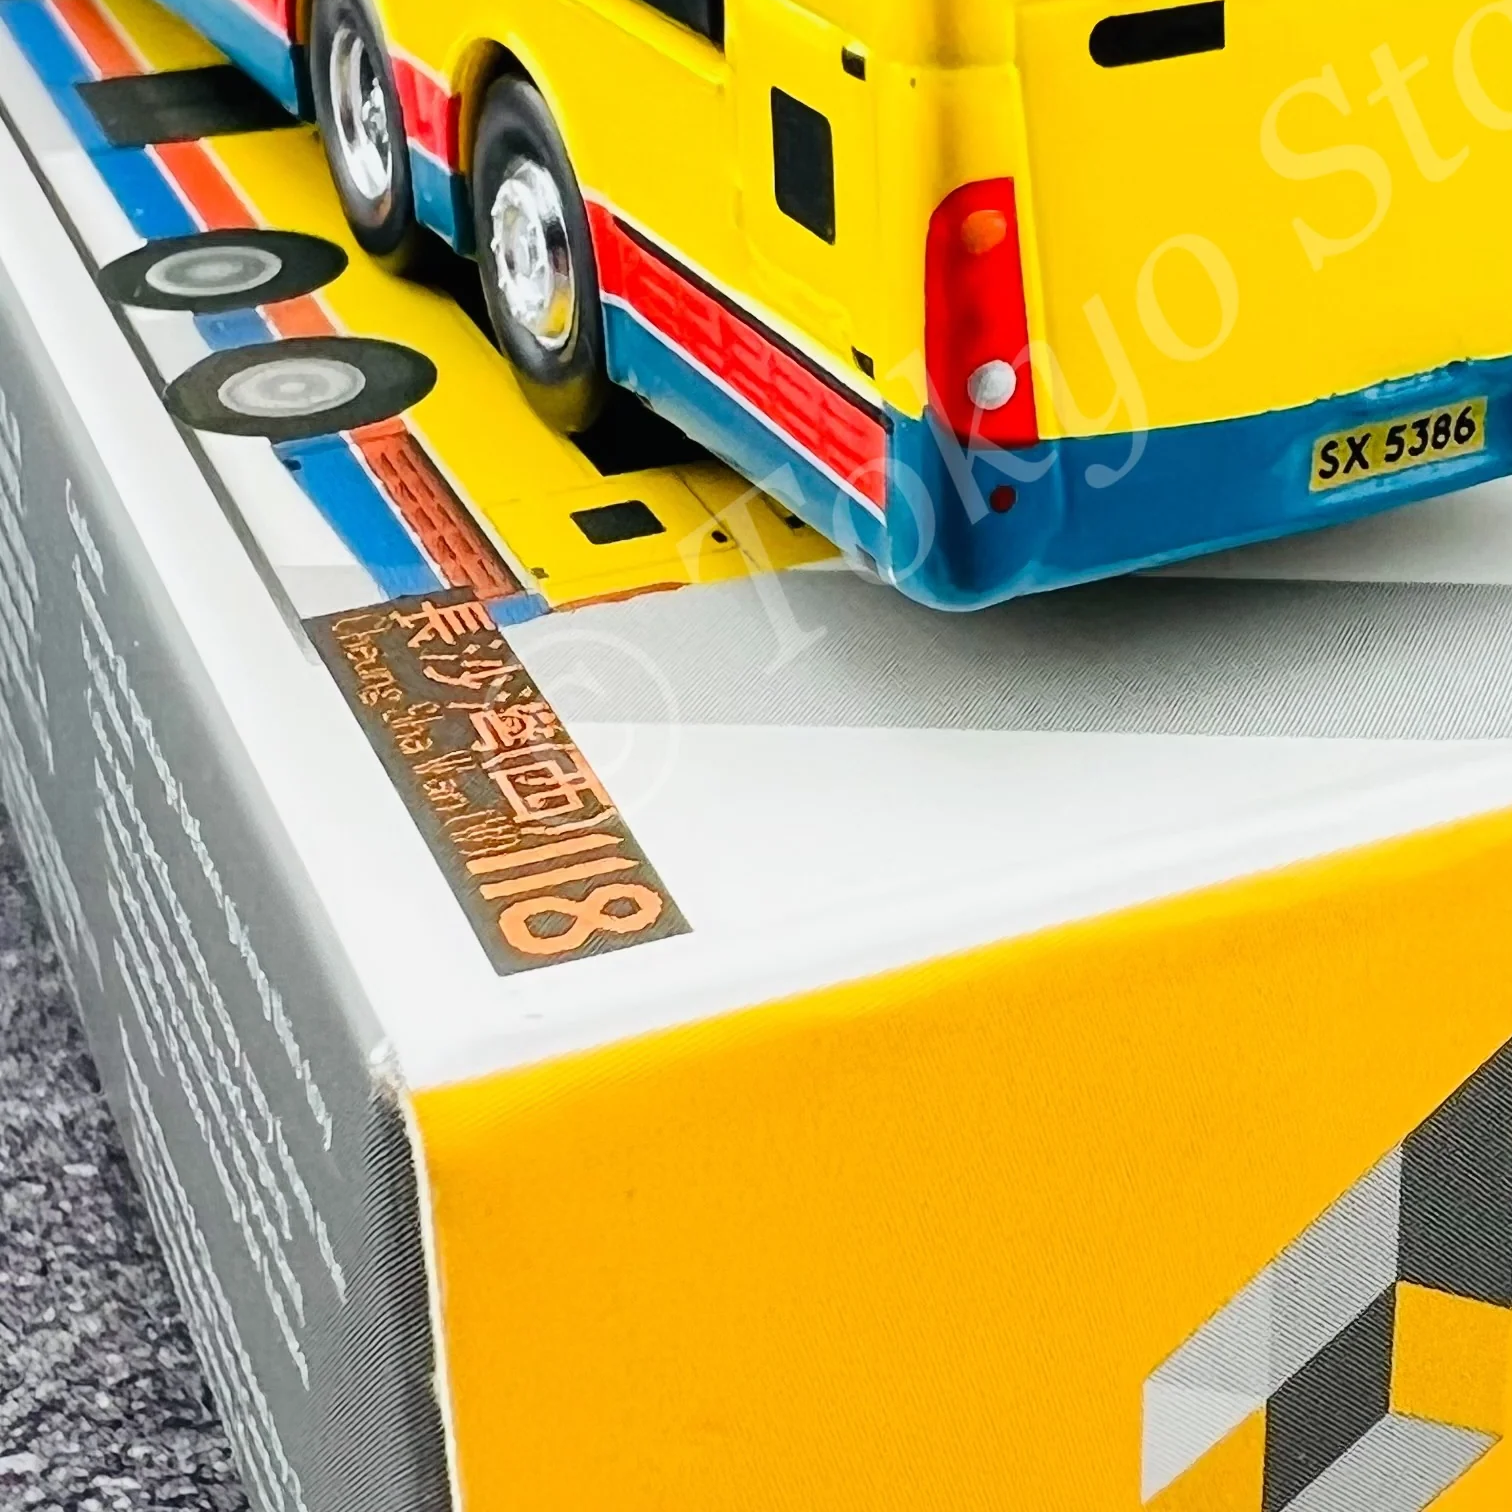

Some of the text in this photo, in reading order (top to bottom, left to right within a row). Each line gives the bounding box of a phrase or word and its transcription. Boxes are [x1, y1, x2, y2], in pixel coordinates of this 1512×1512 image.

[1318, 406, 1476, 479] SX 5386
[331, 614, 402, 706] Cheung
[383, 701, 444, 754] Sha
[465, 833, 664, 955] 118
